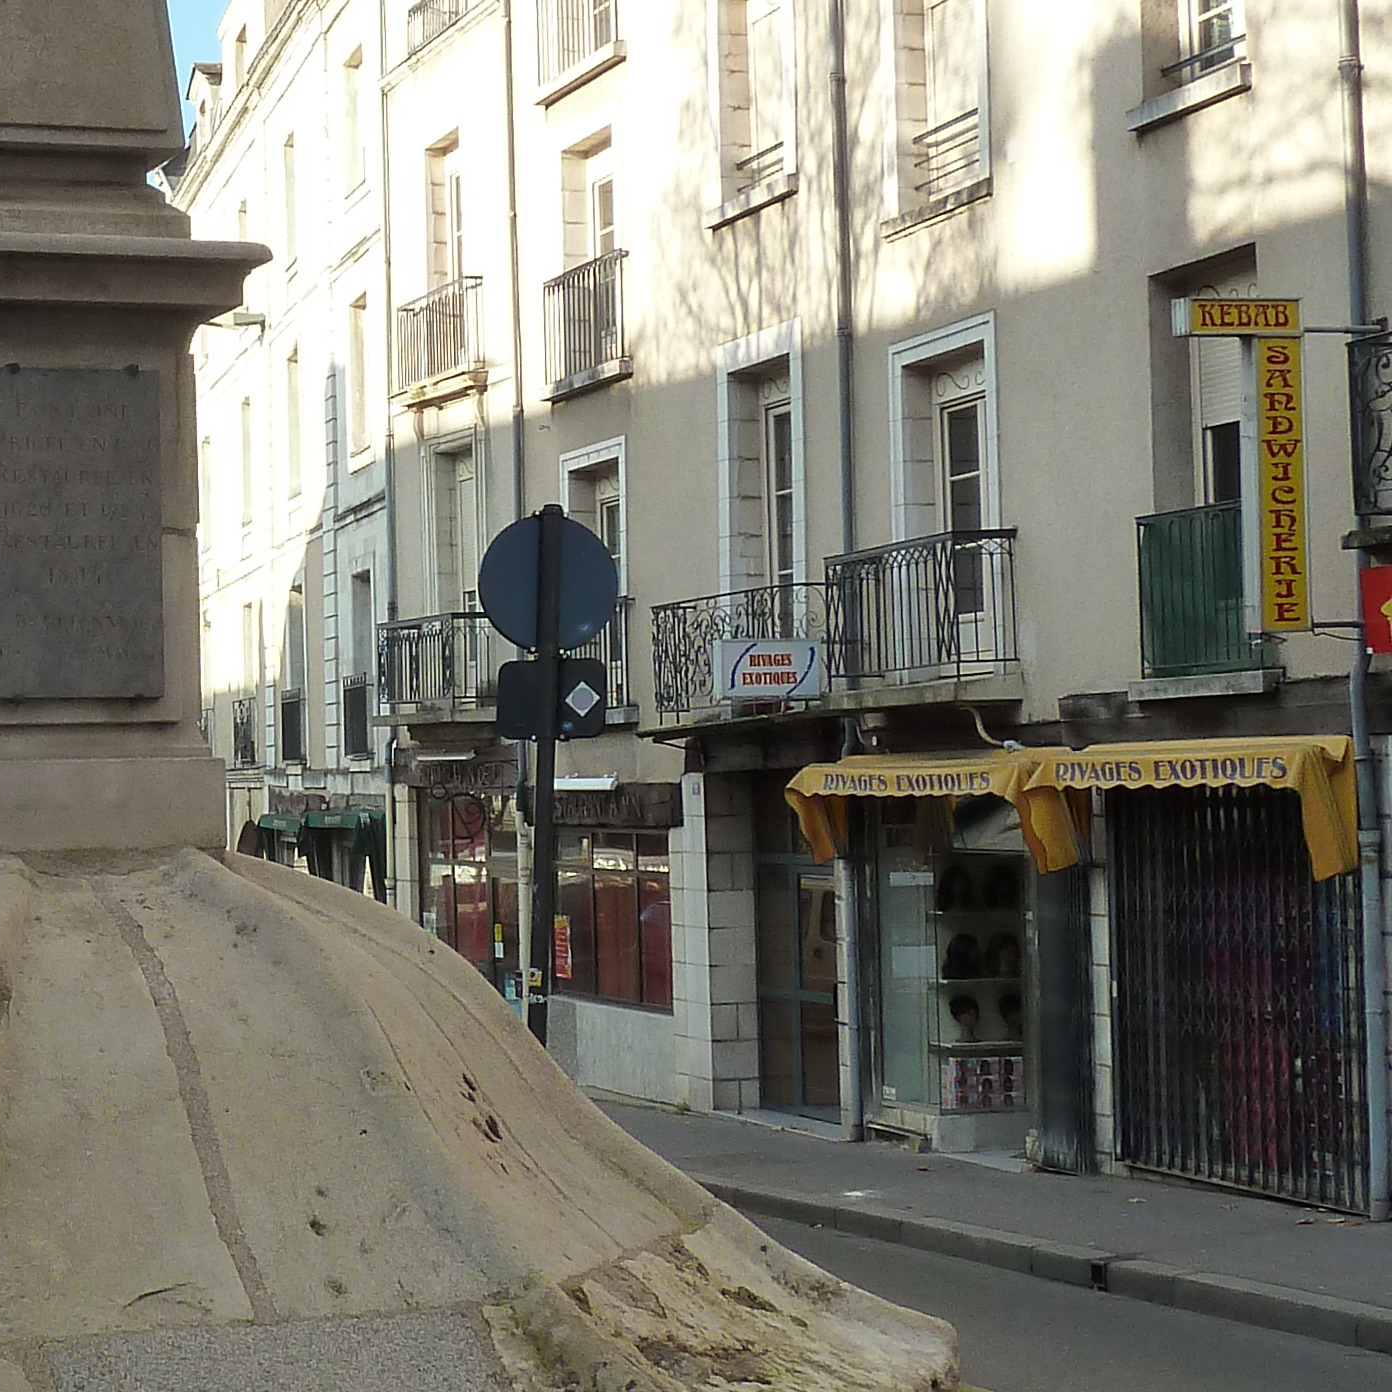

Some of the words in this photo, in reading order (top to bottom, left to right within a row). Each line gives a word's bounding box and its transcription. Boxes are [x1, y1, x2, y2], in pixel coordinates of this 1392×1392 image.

[1198, 304, 1290, 327] KEBAB
[1262, 345, 1303, 622] SANDWICHERIE
[749, 653, 793, 667] RIVAGES
[742, 671, 798, 686] EXOTIQUES
[1054, 761, 1143, 782] RIVAGES
[1154, 757, 1288, 781] EXOTIQUES
[823, 773, 888, 791] RIVAGES
[896, 771, 991, 792] EXOTIQUES
